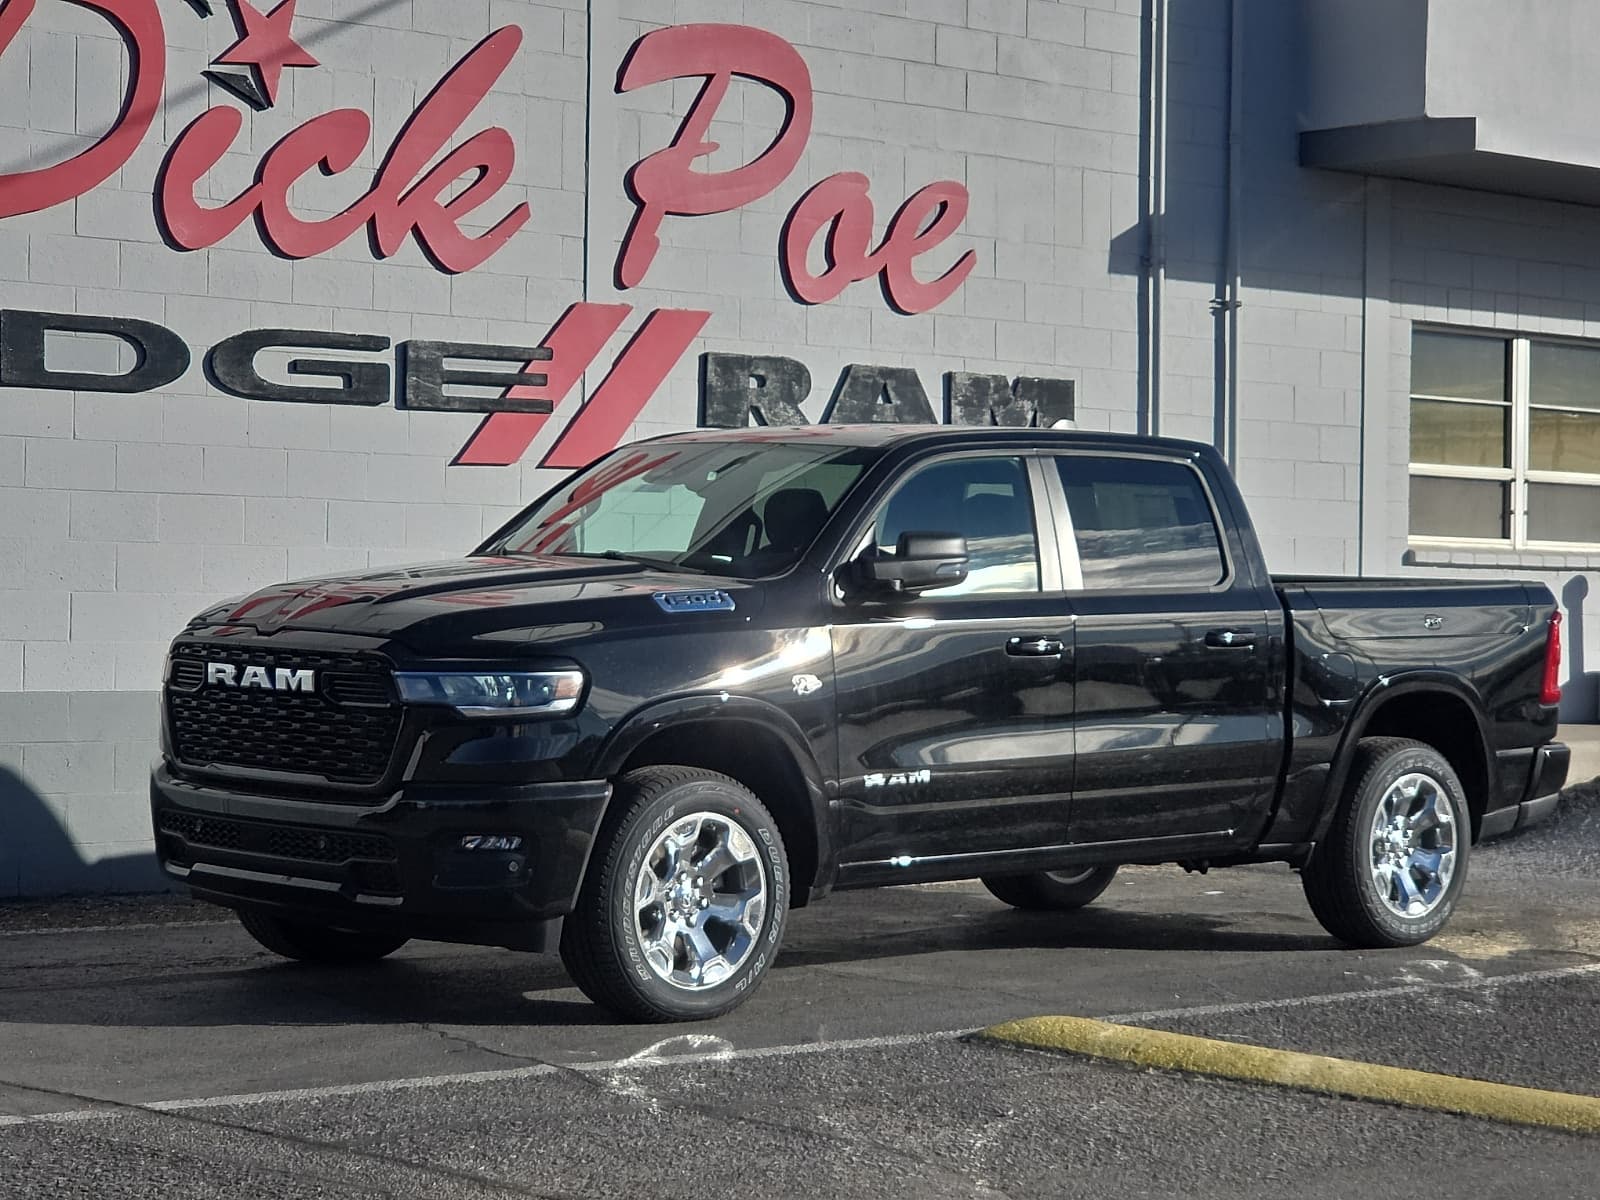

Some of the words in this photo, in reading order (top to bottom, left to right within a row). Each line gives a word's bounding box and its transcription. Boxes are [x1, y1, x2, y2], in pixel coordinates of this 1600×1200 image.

[613, 22, 977, 316] Poe
[697, 351, 1075, 428] RAM
[207, 661, 315, 693] RAM
[863, 769, 931, 788] RAM
[621, 804, 676, 982] BRIDGESTONE
[757, 827, 784, 945] DUELER
